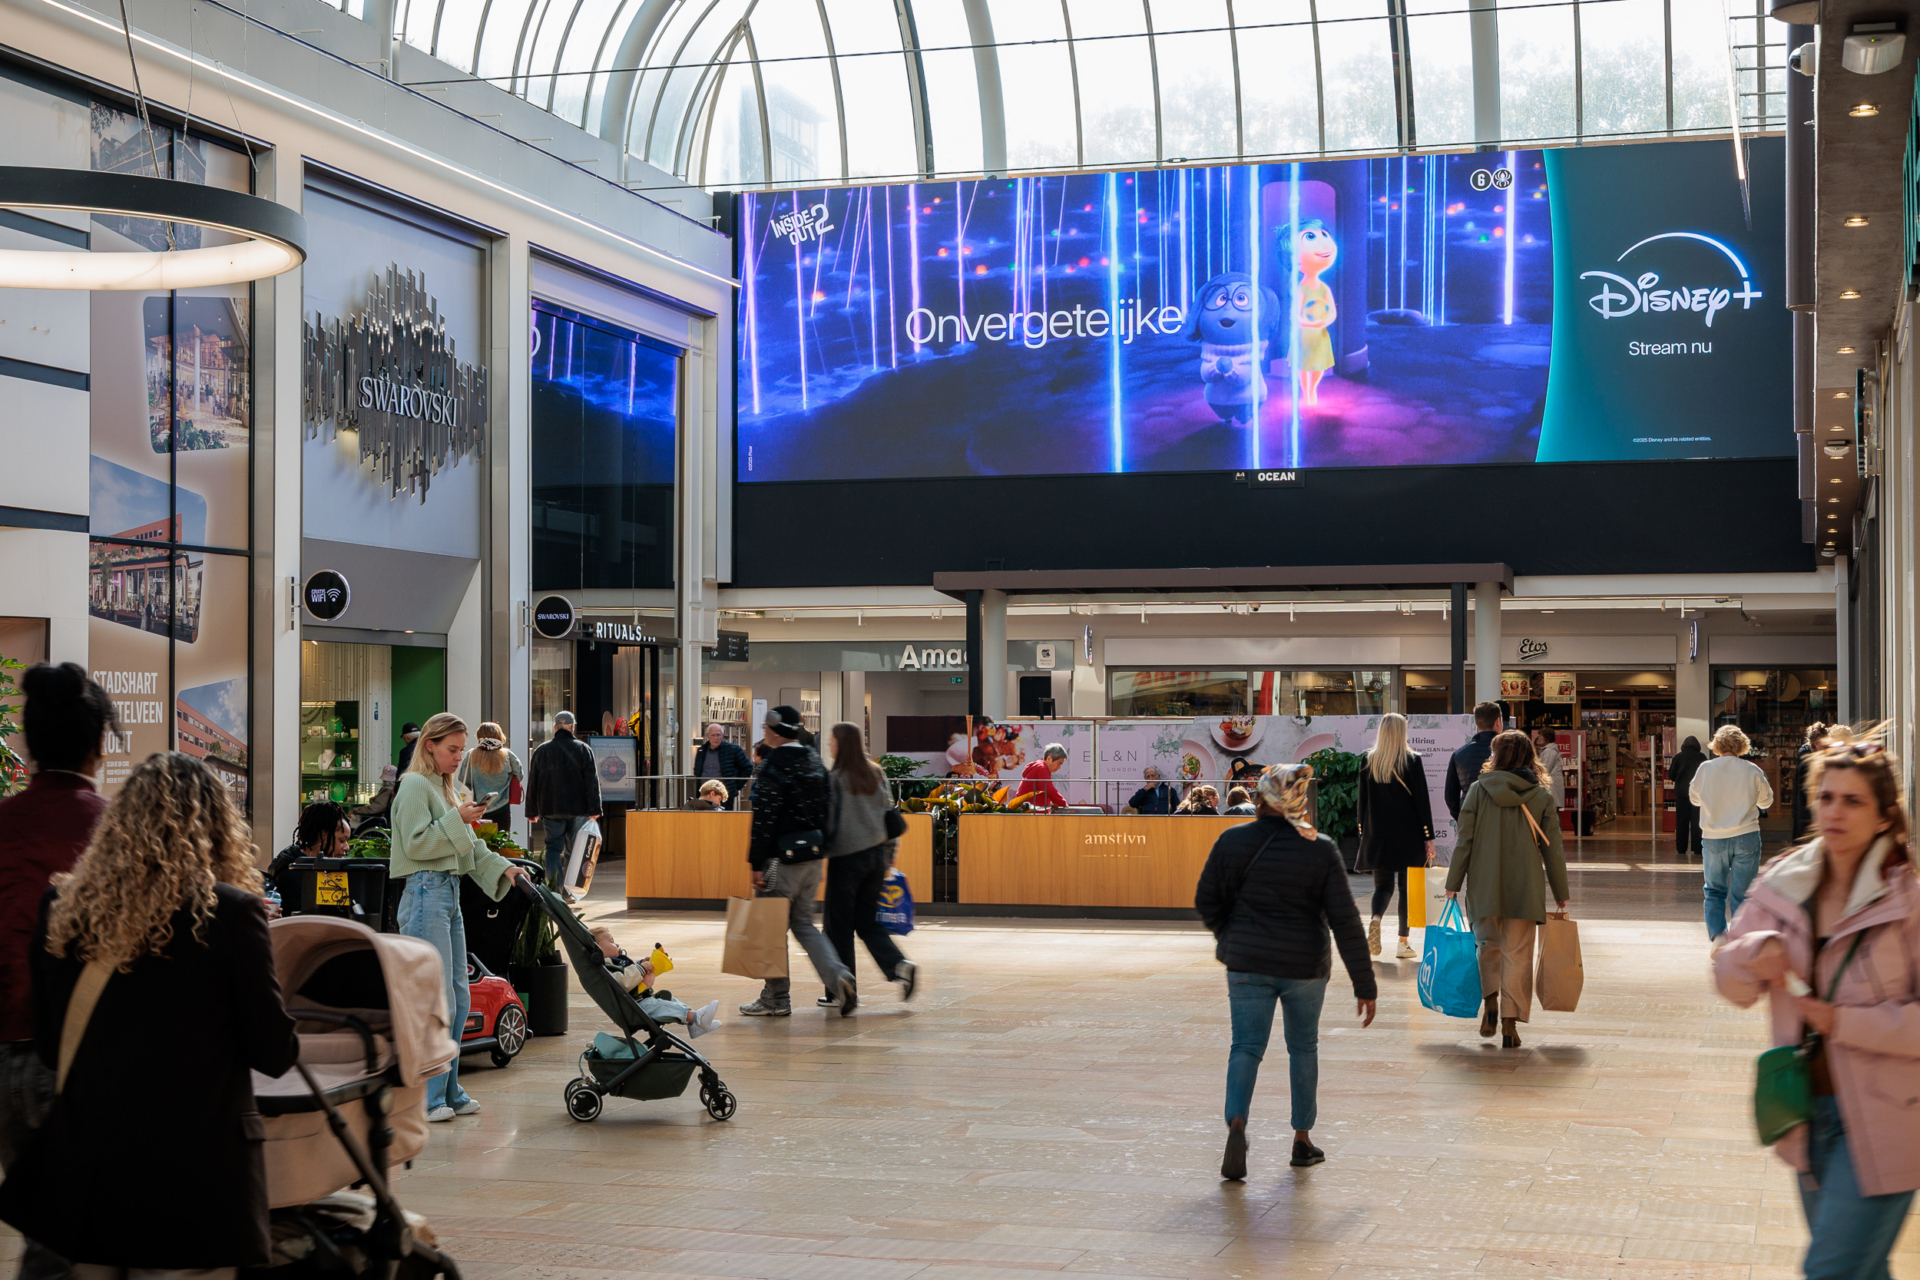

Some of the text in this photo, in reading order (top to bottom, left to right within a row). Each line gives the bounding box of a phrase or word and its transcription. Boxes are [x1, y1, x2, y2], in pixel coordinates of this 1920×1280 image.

[770, 209, 814, 239] INSIDE
[810, 203, 835, 236] 2
[789, 222, 816, 246] OUT
[905, 298, 1183, 349] Onvergetelijke
[1628, 341, 1712, 356] Stream nu
[359, 376, 458, 427] SWAROVSKI
[1257, 472, 1297, 482] OCEAN
[312, 594, 327, 603] WIFI
[537, 613, 570, 621] SWAROVSKI
[1519, 638, 1548, 654] Etos
[899, 644, 968, 669] Ama
[93, 670, 159, 695] STADSHART
[1412, 737, 1435, 745] Hiring
[1085, 831, 1147, 845] amstlvn
